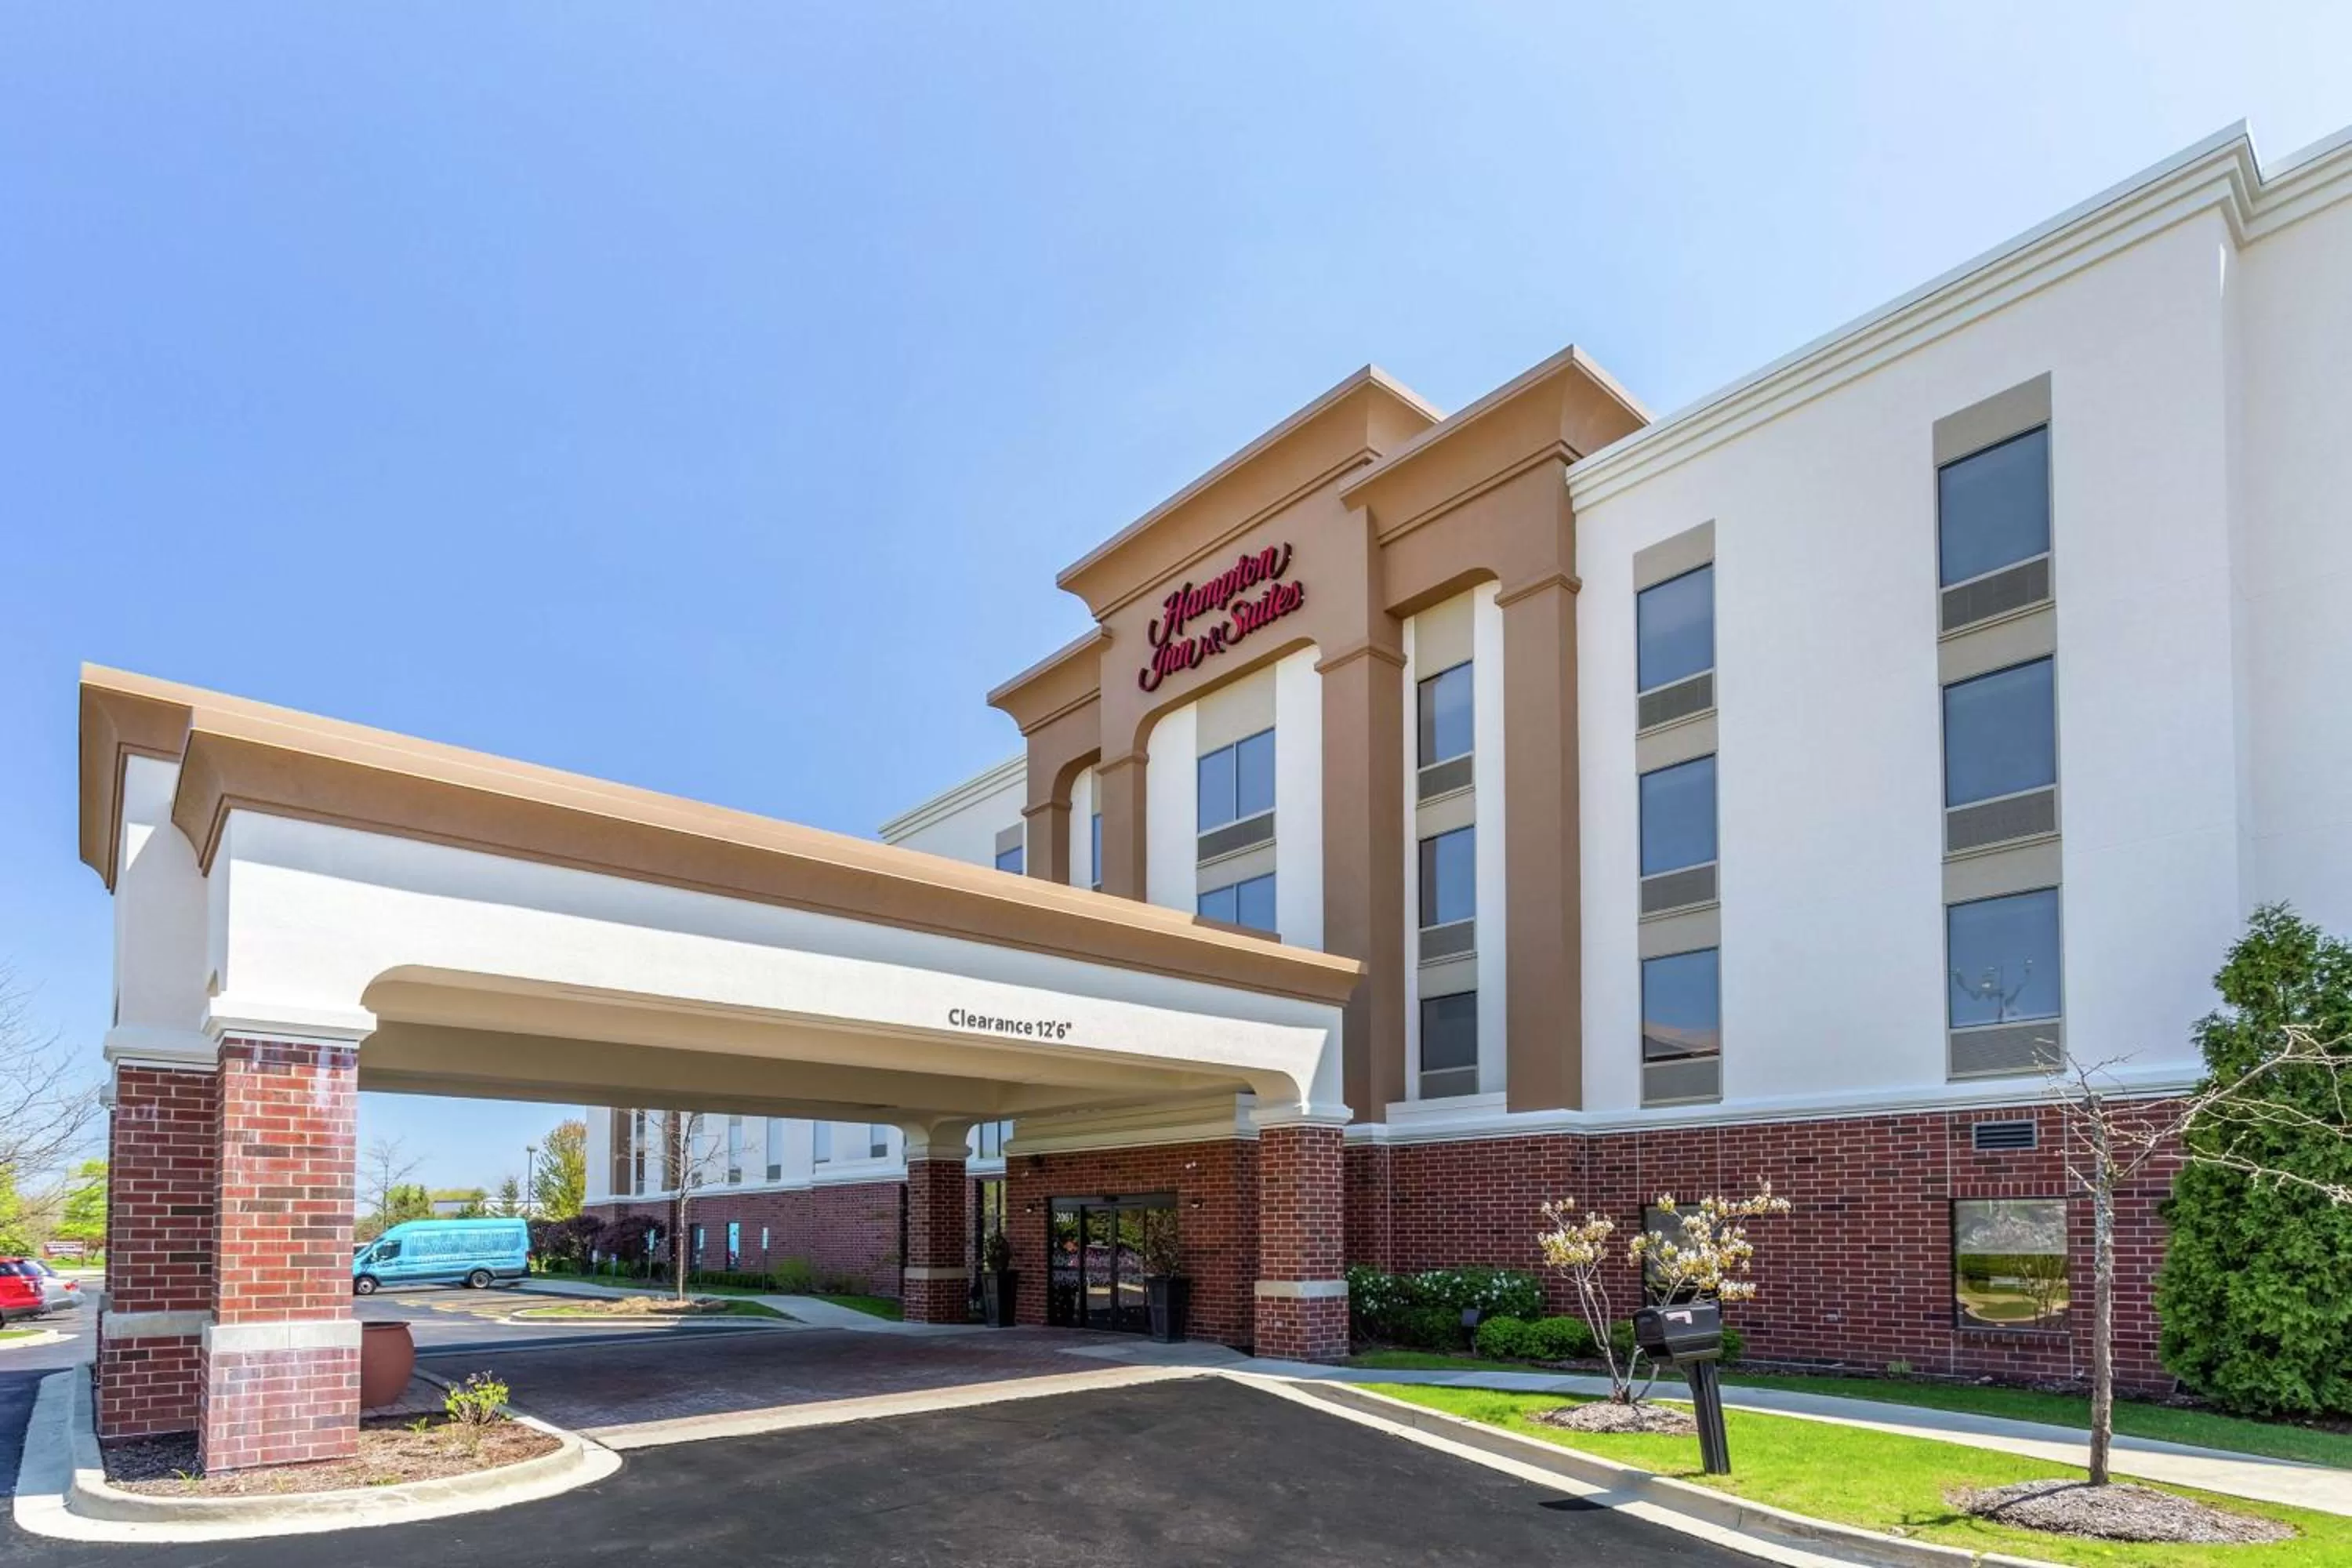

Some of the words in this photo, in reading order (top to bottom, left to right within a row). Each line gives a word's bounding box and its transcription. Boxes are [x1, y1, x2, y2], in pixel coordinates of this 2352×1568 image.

[1138, 635, 1207, 691] Inn
[1204, 626, 1225, 655] &
[1221, 580, 1305, 645] Suites
[1148, 542, 1292, 648] Hampton
[948, 1008, 1033, 1035] Clearance
[1036, 1021, 1072, 1039] 12'6"
